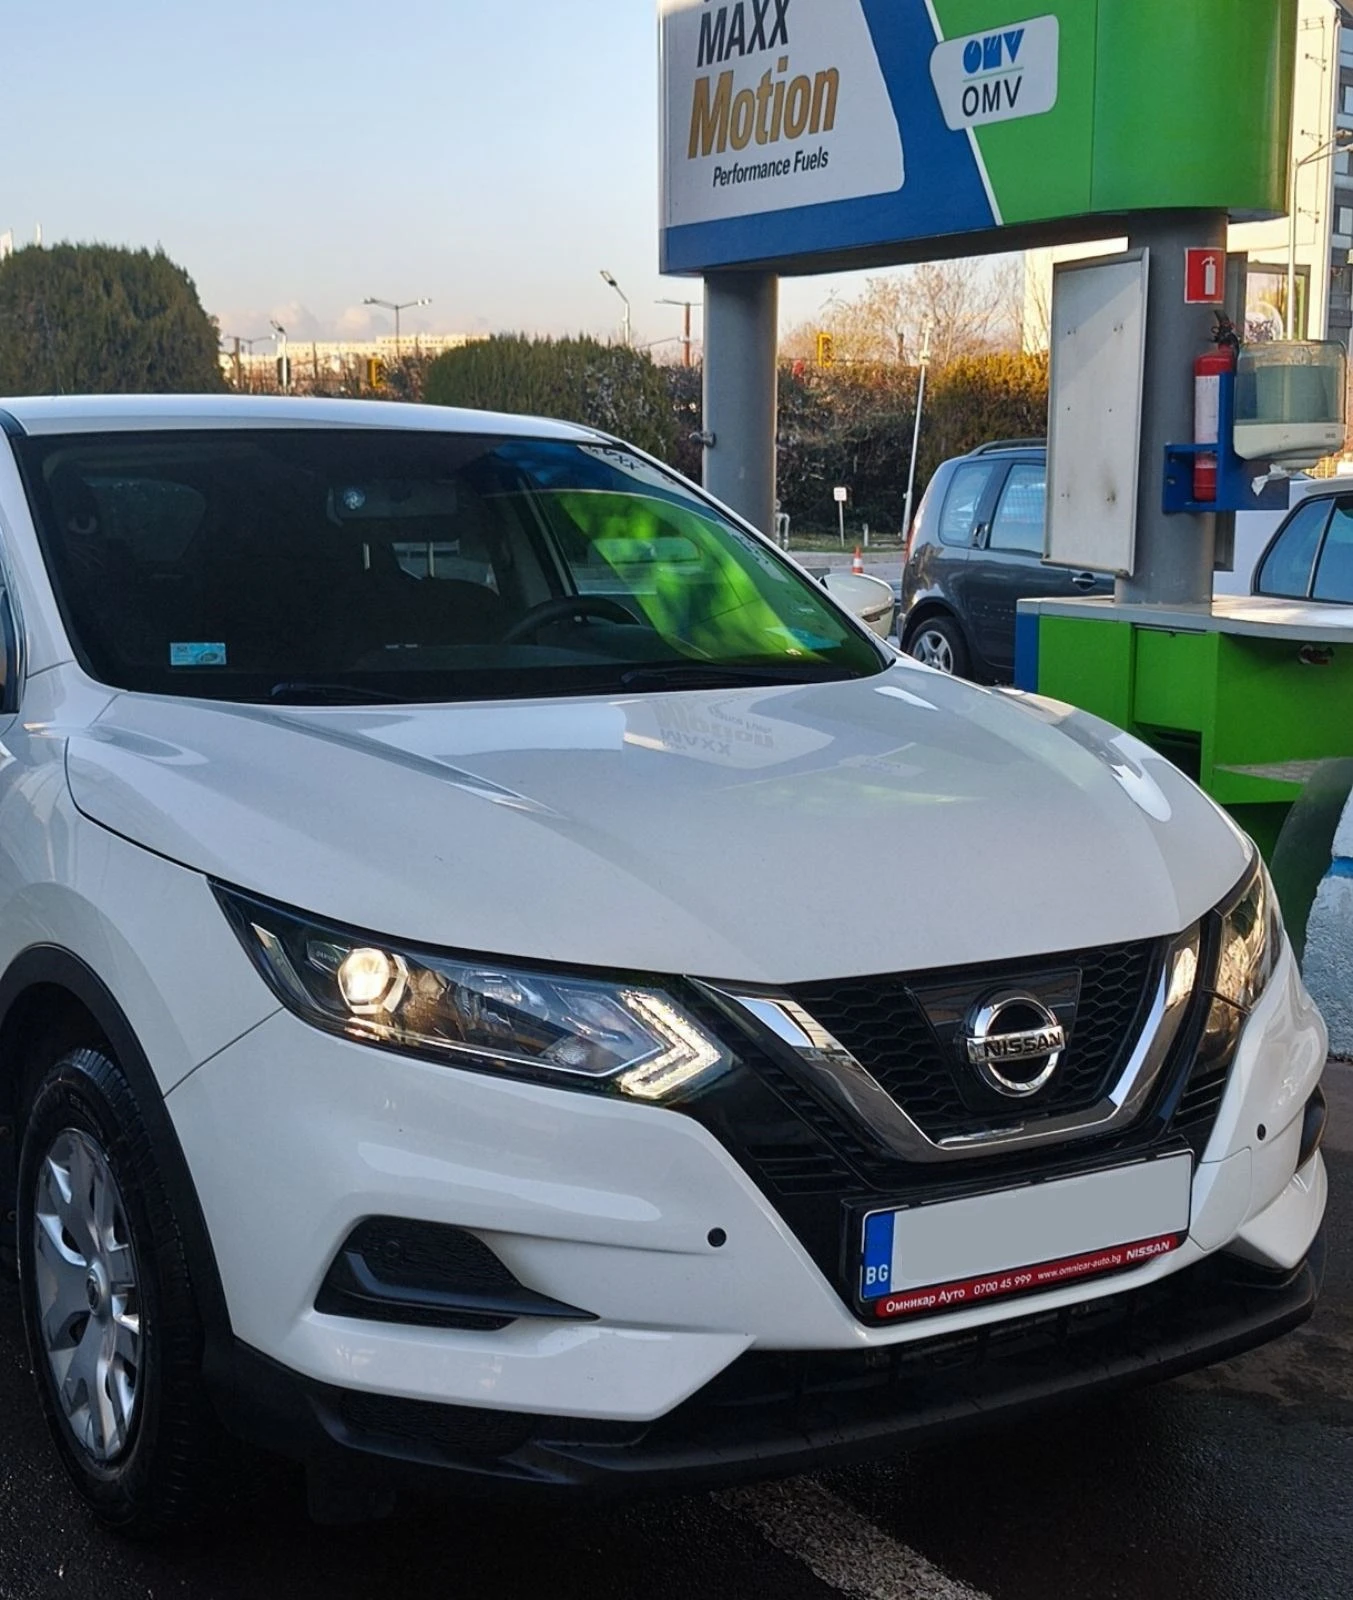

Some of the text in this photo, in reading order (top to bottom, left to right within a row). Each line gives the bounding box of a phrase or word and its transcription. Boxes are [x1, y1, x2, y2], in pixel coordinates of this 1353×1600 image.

[697, 0, 789, 68] MAXX
[688, 55, 839, 160] Motion
[962, 75, 1022, 117] OMV
[713, 146, 829, 187] Performance Fuels
[982, 1031, 1061, 1057] NISSAN
[866, 1263, 889, 1285] BG
[886, 1240, 1170, 1313] Омникар Ауто 0700 45 999 www.omnicar-auto.bg NISSAN
